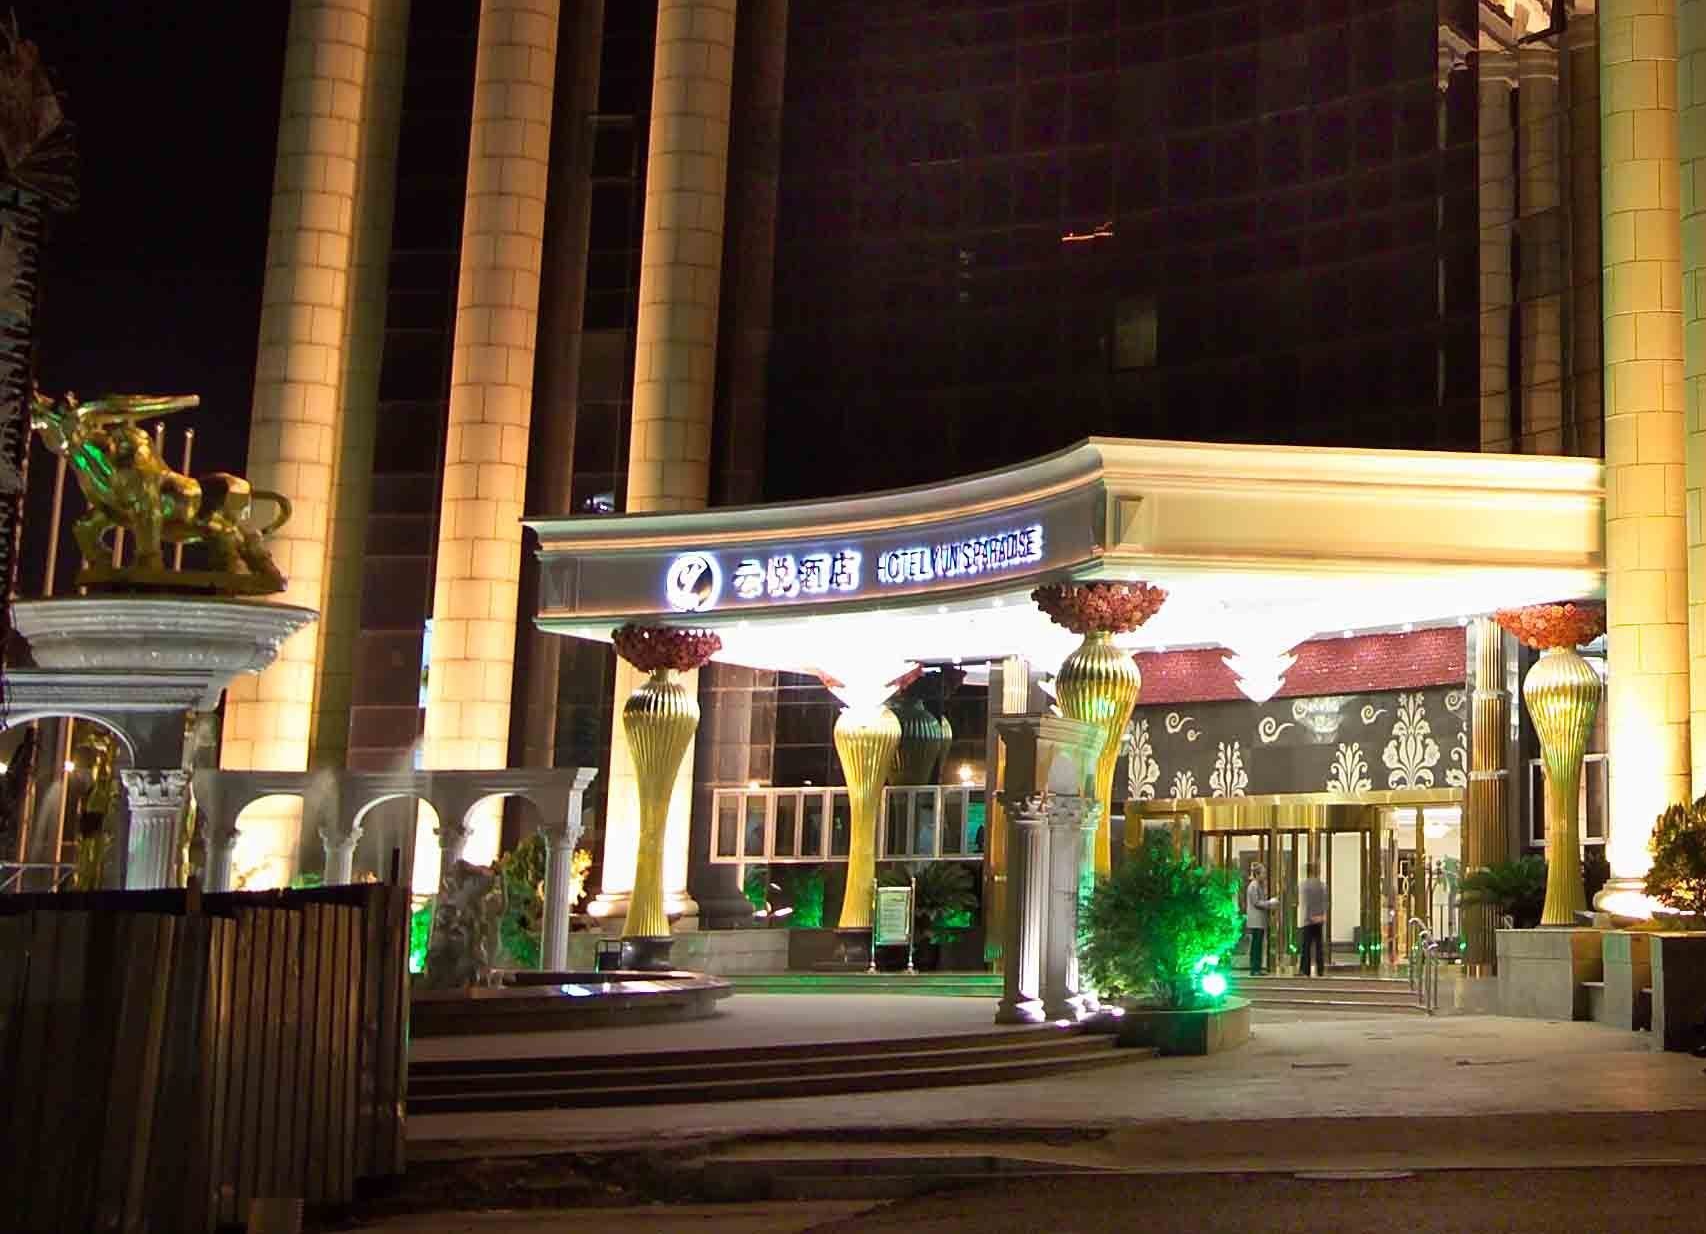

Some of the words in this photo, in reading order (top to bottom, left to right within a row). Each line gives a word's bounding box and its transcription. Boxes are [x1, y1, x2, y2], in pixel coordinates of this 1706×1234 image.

[732, 551, 862, 598] 云悦酒店
[876, 549, 931, 579] HOTEL
